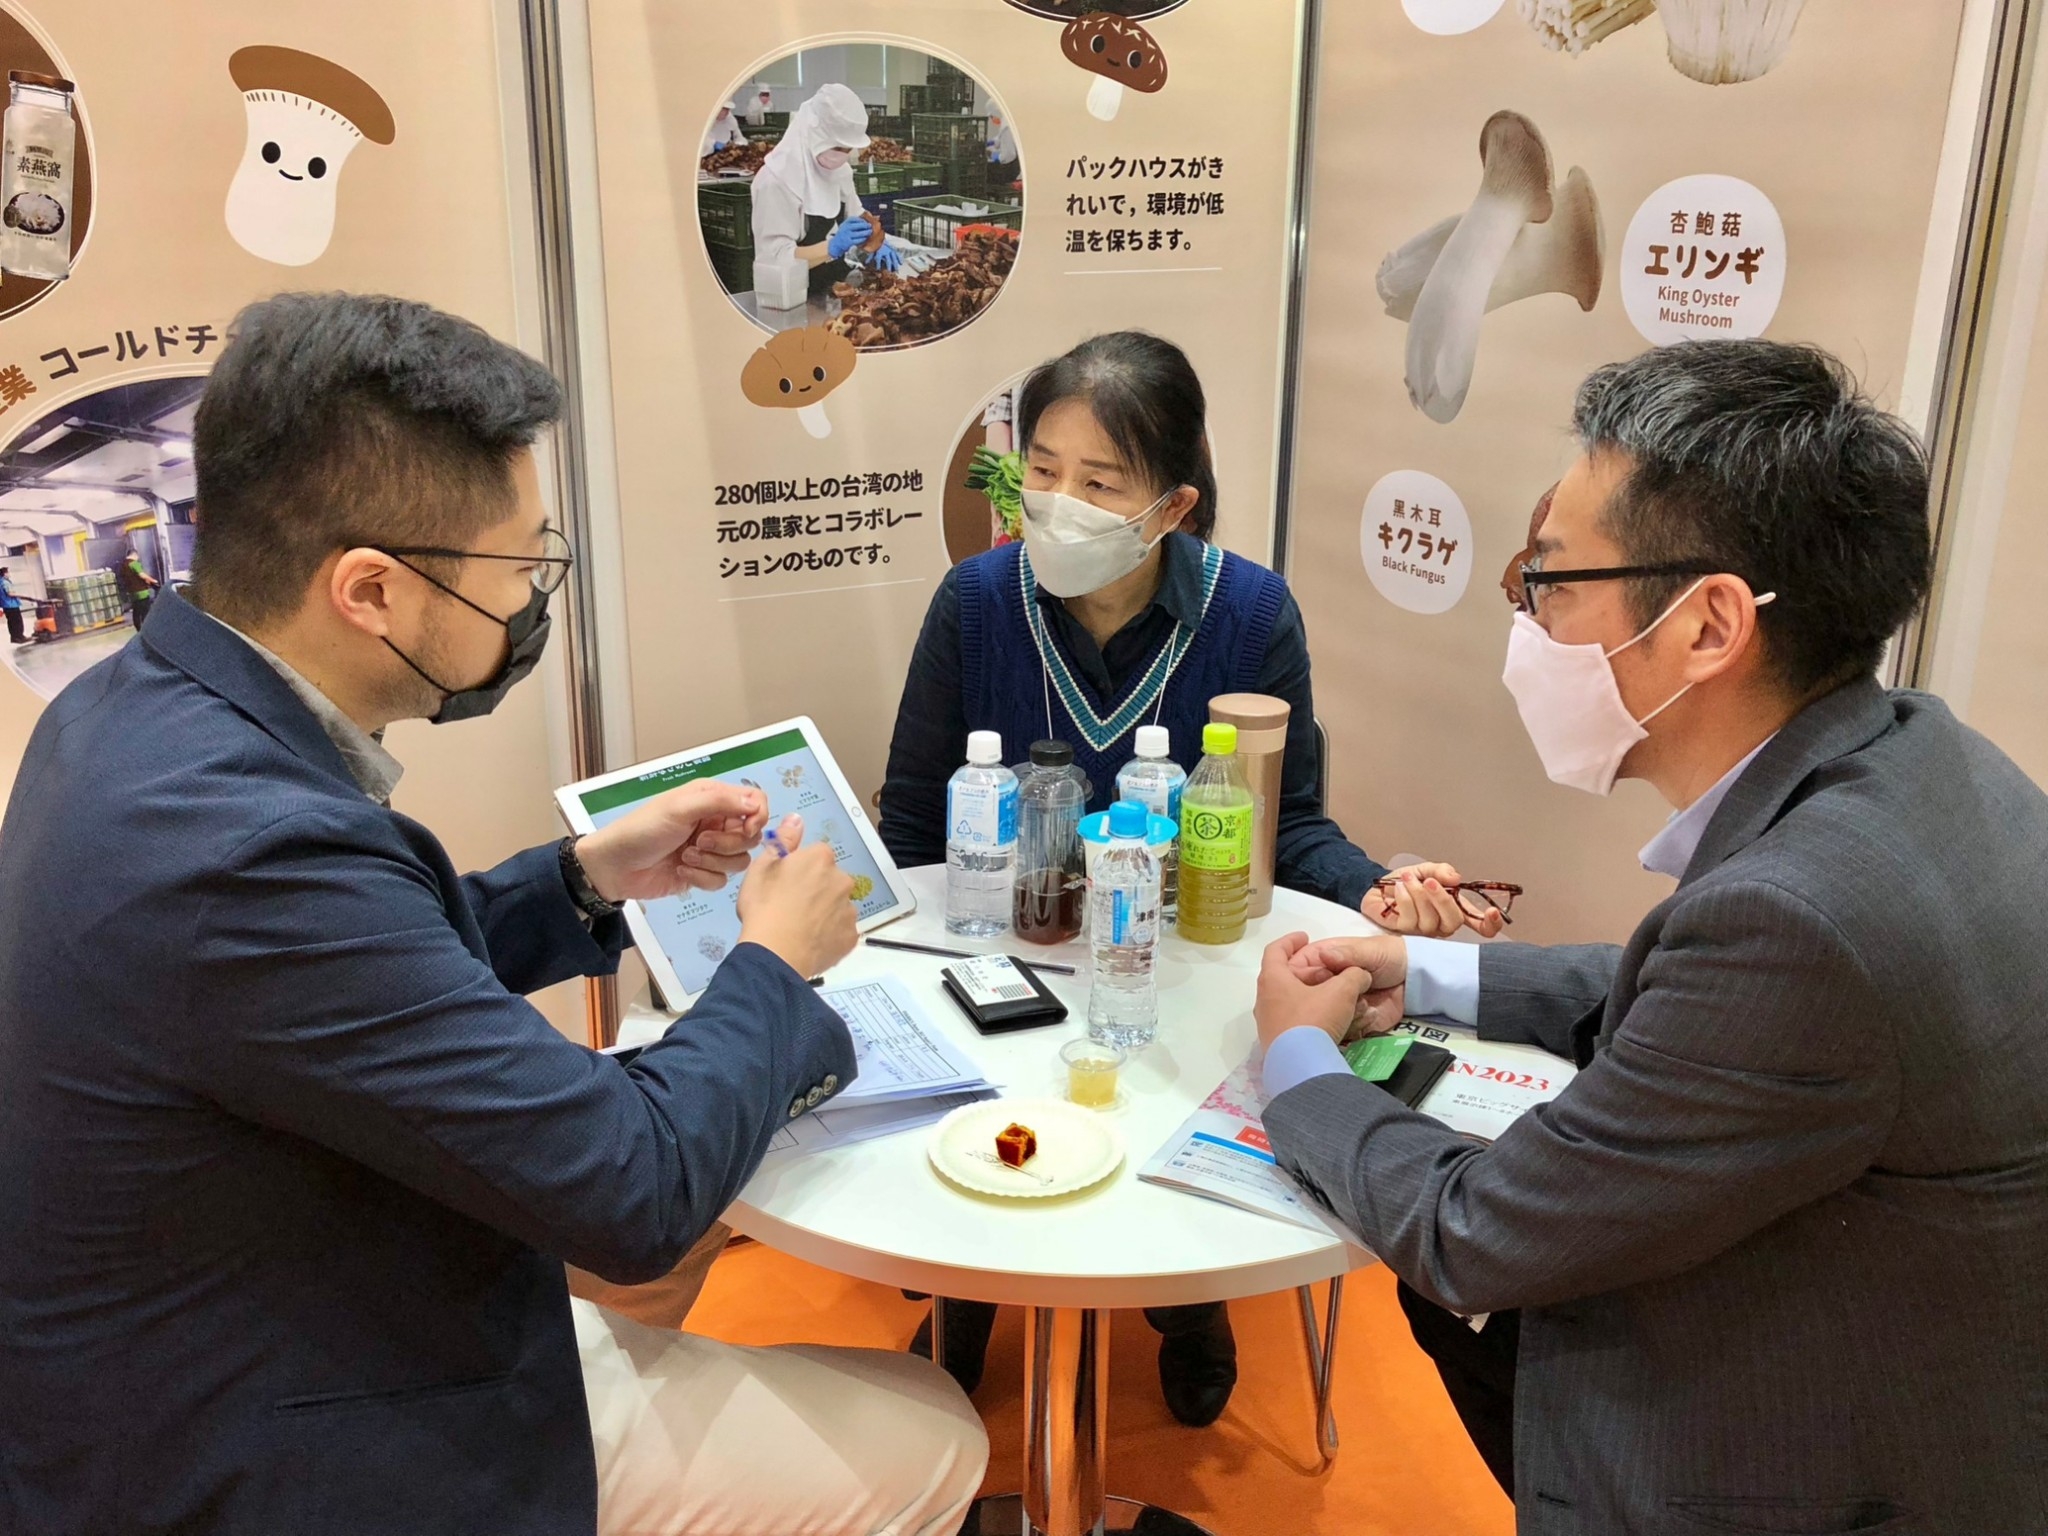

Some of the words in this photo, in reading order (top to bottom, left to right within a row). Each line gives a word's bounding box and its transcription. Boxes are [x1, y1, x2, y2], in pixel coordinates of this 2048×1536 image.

[1066, 155, 1224, 180] パックハウスがき
[1670, 210, 1742, 238] 杏鮑菇
[1065, 228, 1191, 253] 温を保ちます。
[1644, 244, 1765, 285] エリンギ
[1657, 285, 1689, 306] King
[1692, 288, 1740, 308] Oyster
[1659, 307, 1733, 329] Mushroom
[714, 468, 924, 506] 280個以上の台湾の地
[716, 506, 923, 543] 元の農家とコラボレー
[1378, 521, 1458, 566] キクラゲ
[719, 542, 891, 579] ションのものです。
[1382, 555, 1408, 574] Black
[1410, 564, 1446, 585] Fungus
[1222, 814, 1237, 839] 京都
